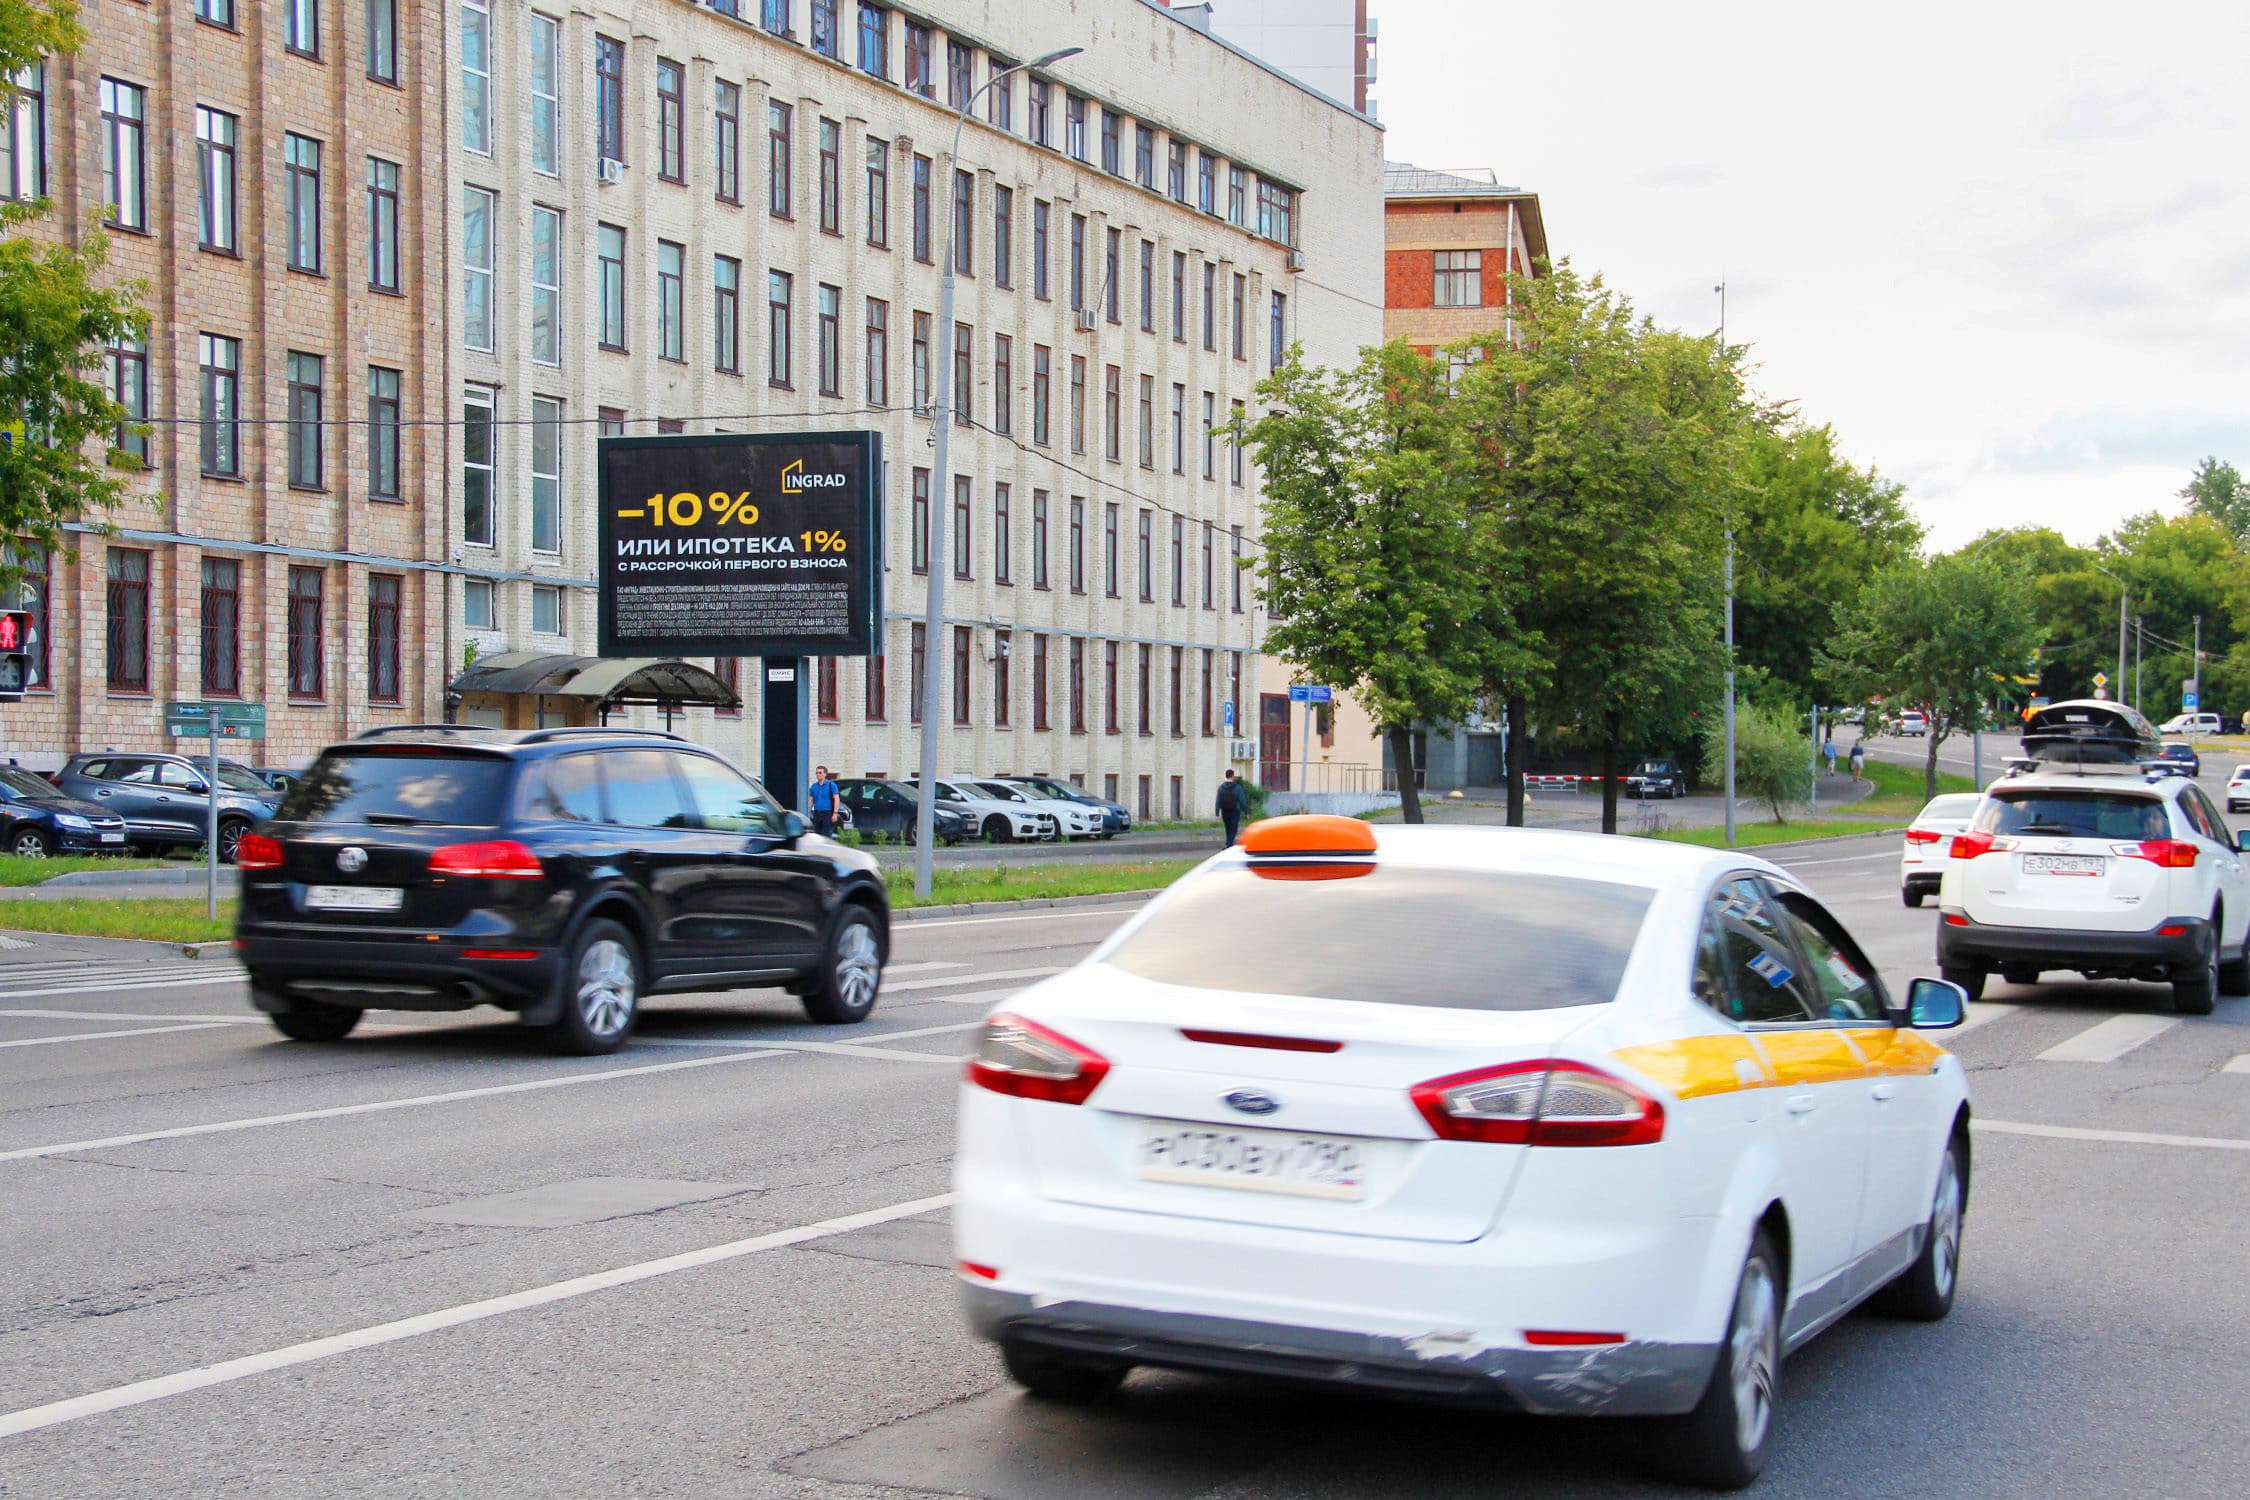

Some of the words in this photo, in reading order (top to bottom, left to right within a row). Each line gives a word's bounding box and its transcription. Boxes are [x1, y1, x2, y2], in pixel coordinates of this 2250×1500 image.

[786, 474, 846, 489] INGRAD
[617, 539, 671, 556] ИЛИ
[677, 537, 795, 555] ИПОТЕКА
[801, 530, 847, 553] 1%
[618, 562, 627, 571] С
[630, 559, 722, 571] РАССРОЧКОЙ
[724, 559, 787, 570] ПЕРВОГО
[790, 558, 848, 569] ВЗНОСА
